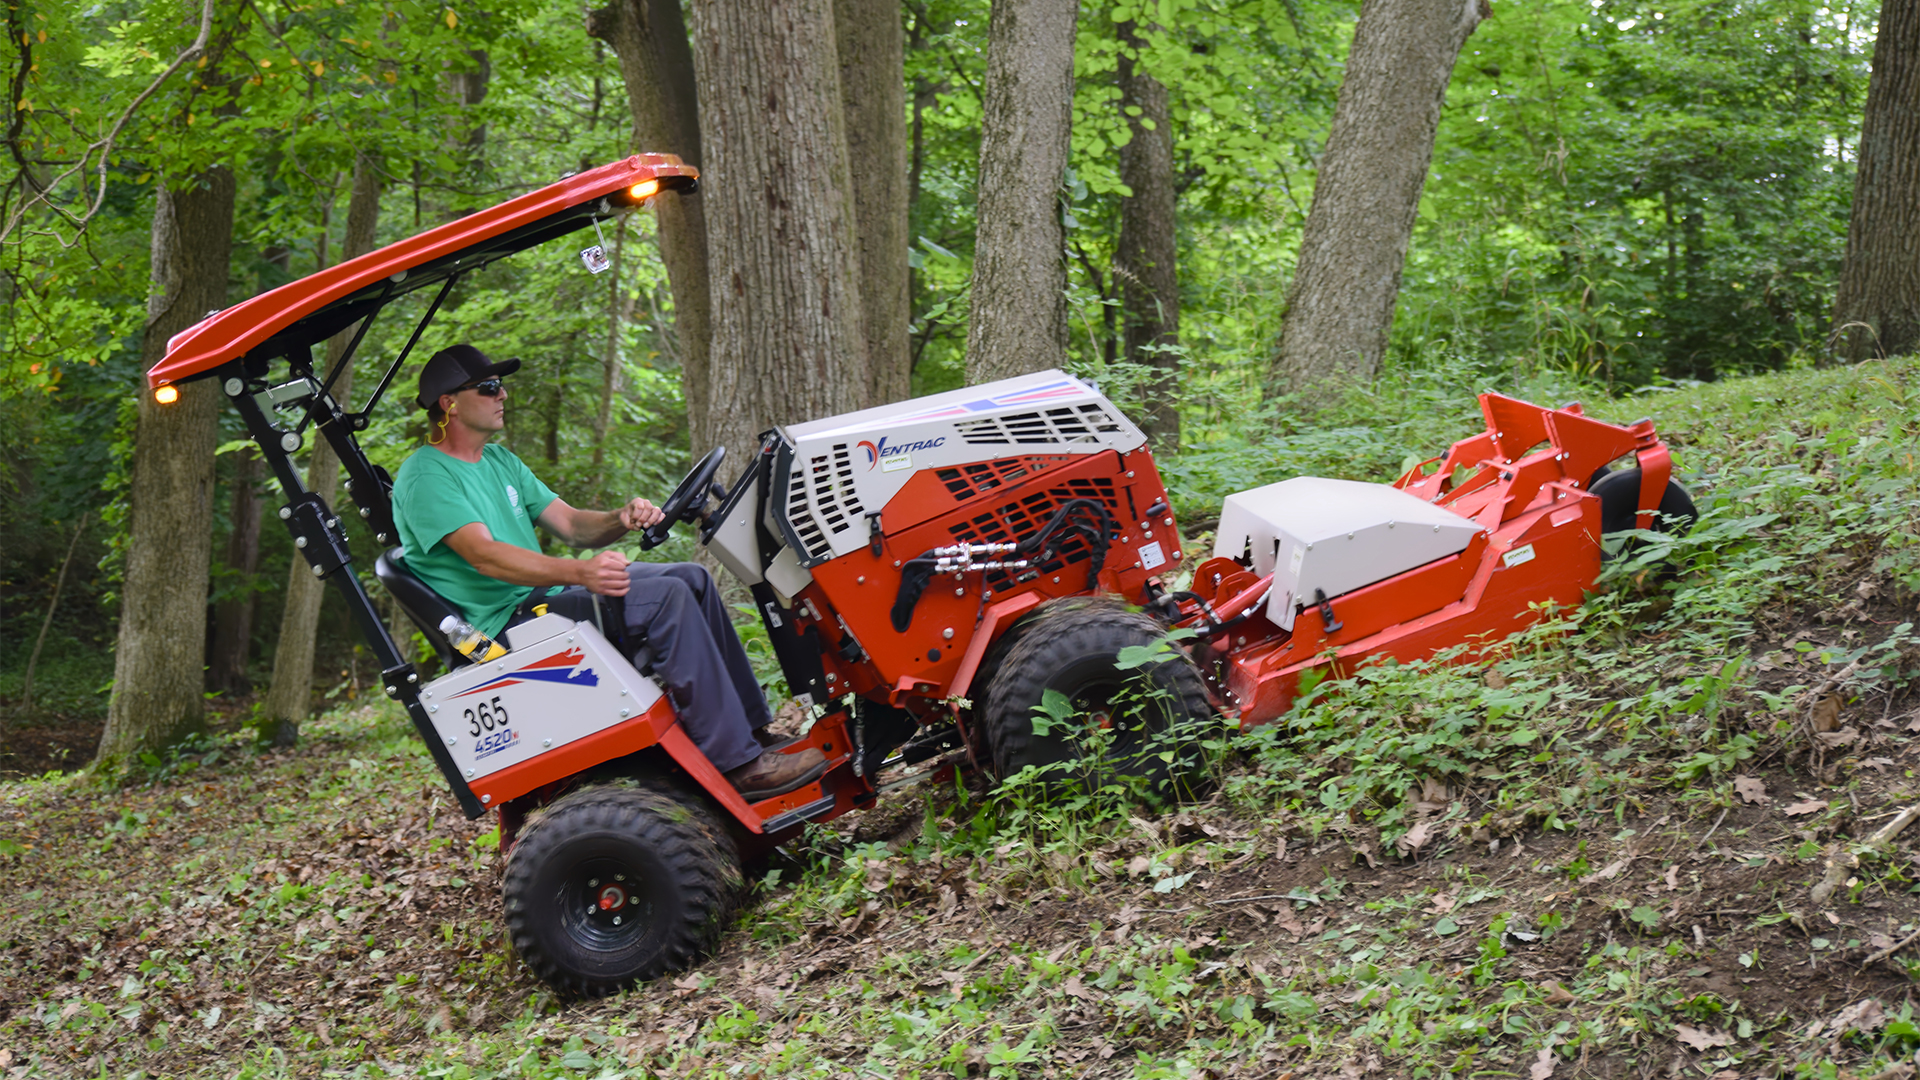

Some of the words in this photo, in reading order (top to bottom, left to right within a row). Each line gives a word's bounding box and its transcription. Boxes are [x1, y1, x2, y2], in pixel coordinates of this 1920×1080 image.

[856, 436, 946, 472] VENTRAC
[464, 696, 508, 737] 365
[475, 728, 511, 754] 4520
